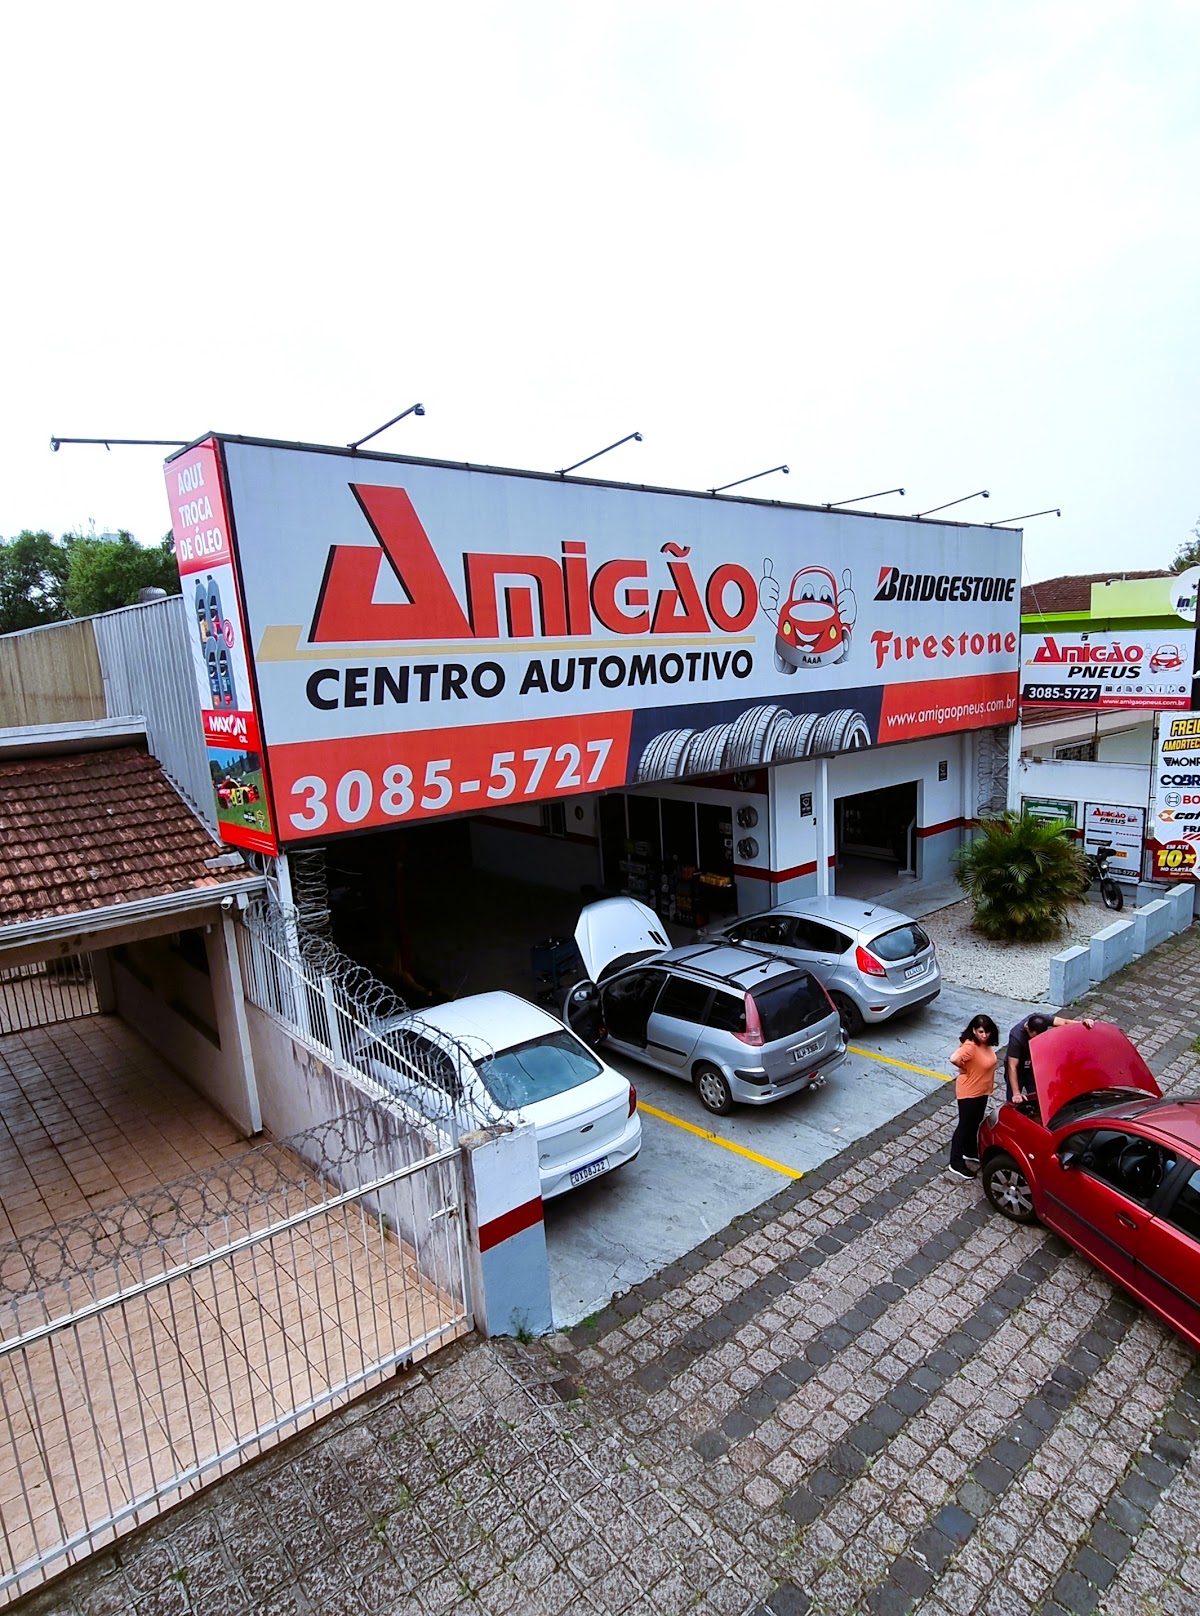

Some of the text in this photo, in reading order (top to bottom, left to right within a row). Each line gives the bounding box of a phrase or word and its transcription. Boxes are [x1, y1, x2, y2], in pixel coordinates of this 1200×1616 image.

[177, 462, 204, 495] AQUI
[178, 496, 213, 528] TROCA
[180, 526, 222, 562] DE ÓLEO
[873, 566, 1016, 602] BRIDGESTONE
[870, 630, 1017, 669] Firestone
[305, 649, 753, 710] CENTRO AUTOMOTIVO
[1067, 665, 1142, 679] PNEUS
[1028, 686, 1098, 700] 3085-5727
[1103, 698, 1185, 707] www.amigaopneus.com.br
[887, 694, 1016, 727] www.amigaopneus.com.br
[288, 738, 614, 831] 3085-5727
[1099, 817, 1126, 825] PNEUS
